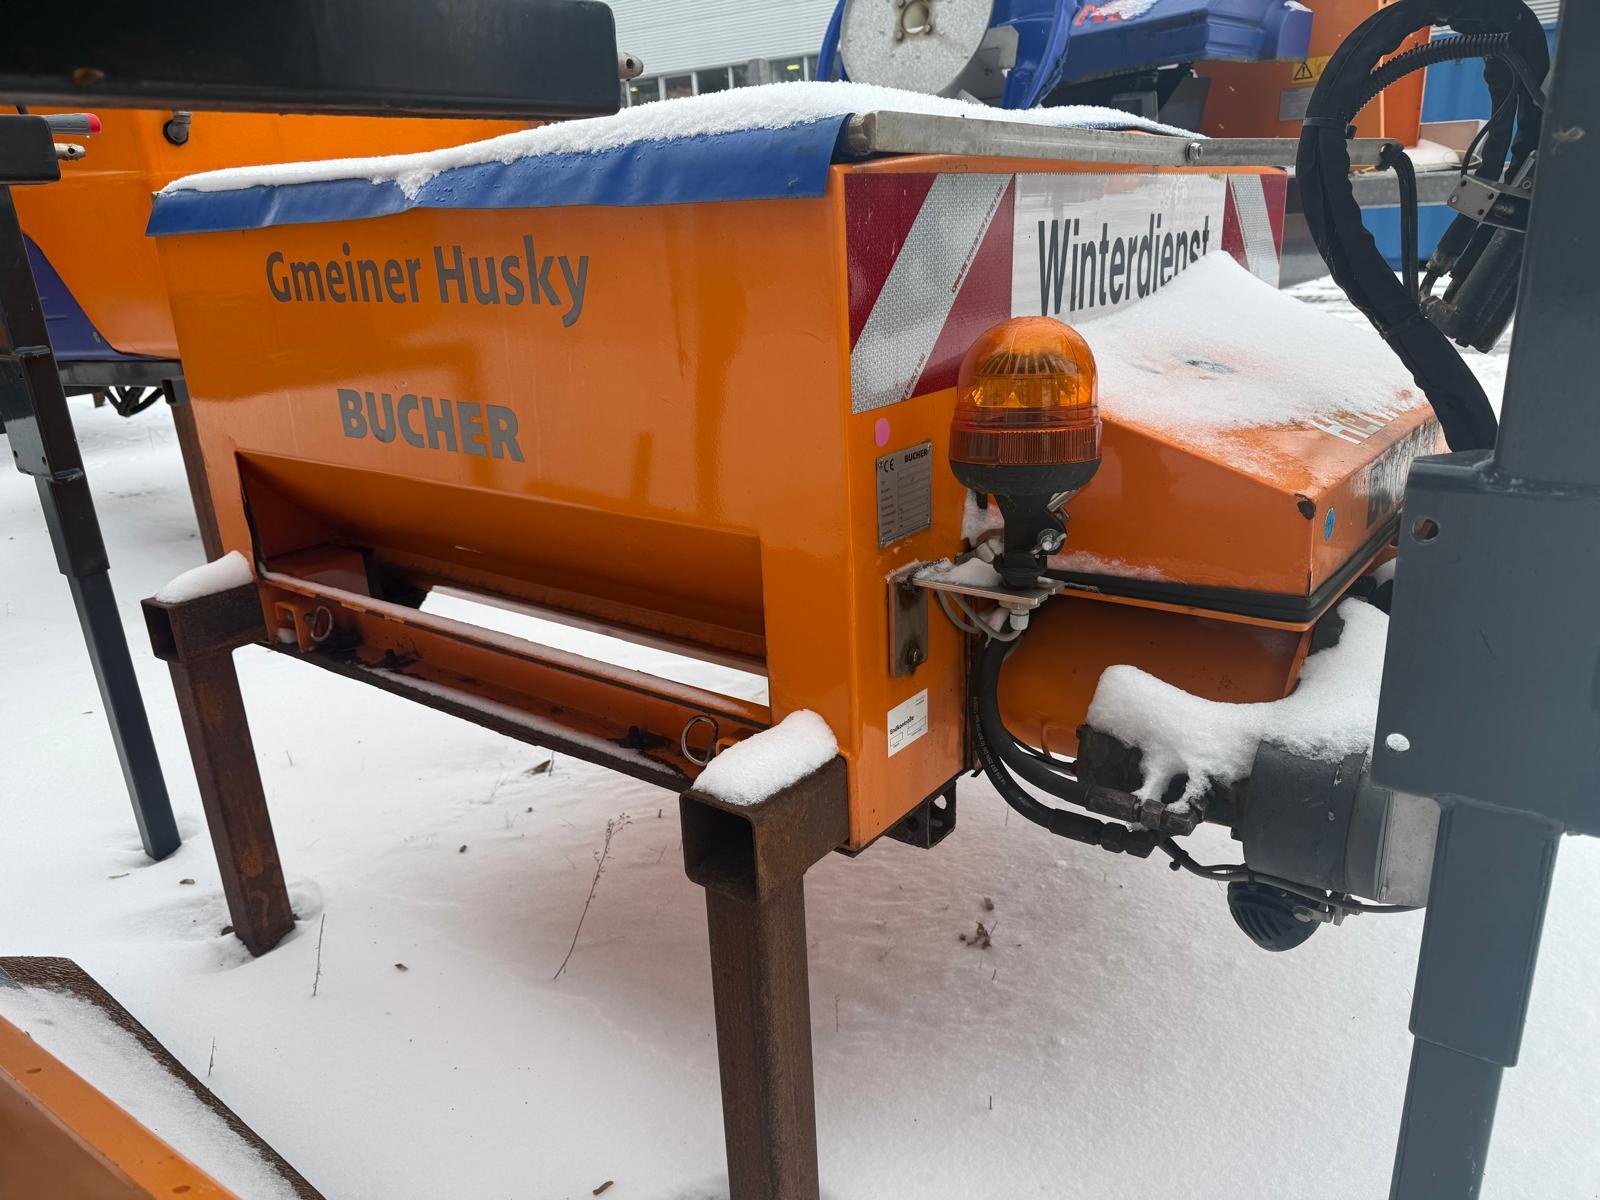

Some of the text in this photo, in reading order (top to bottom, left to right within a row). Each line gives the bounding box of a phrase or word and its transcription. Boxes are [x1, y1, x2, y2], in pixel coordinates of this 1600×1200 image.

[266, 234, 589, 328] Gmeiner Husky
[1038, 213, 1210, 316] Winterdienst
[337, 388, 525, 463] BUCHER
[904, 448, 929, 463] BUCHER
